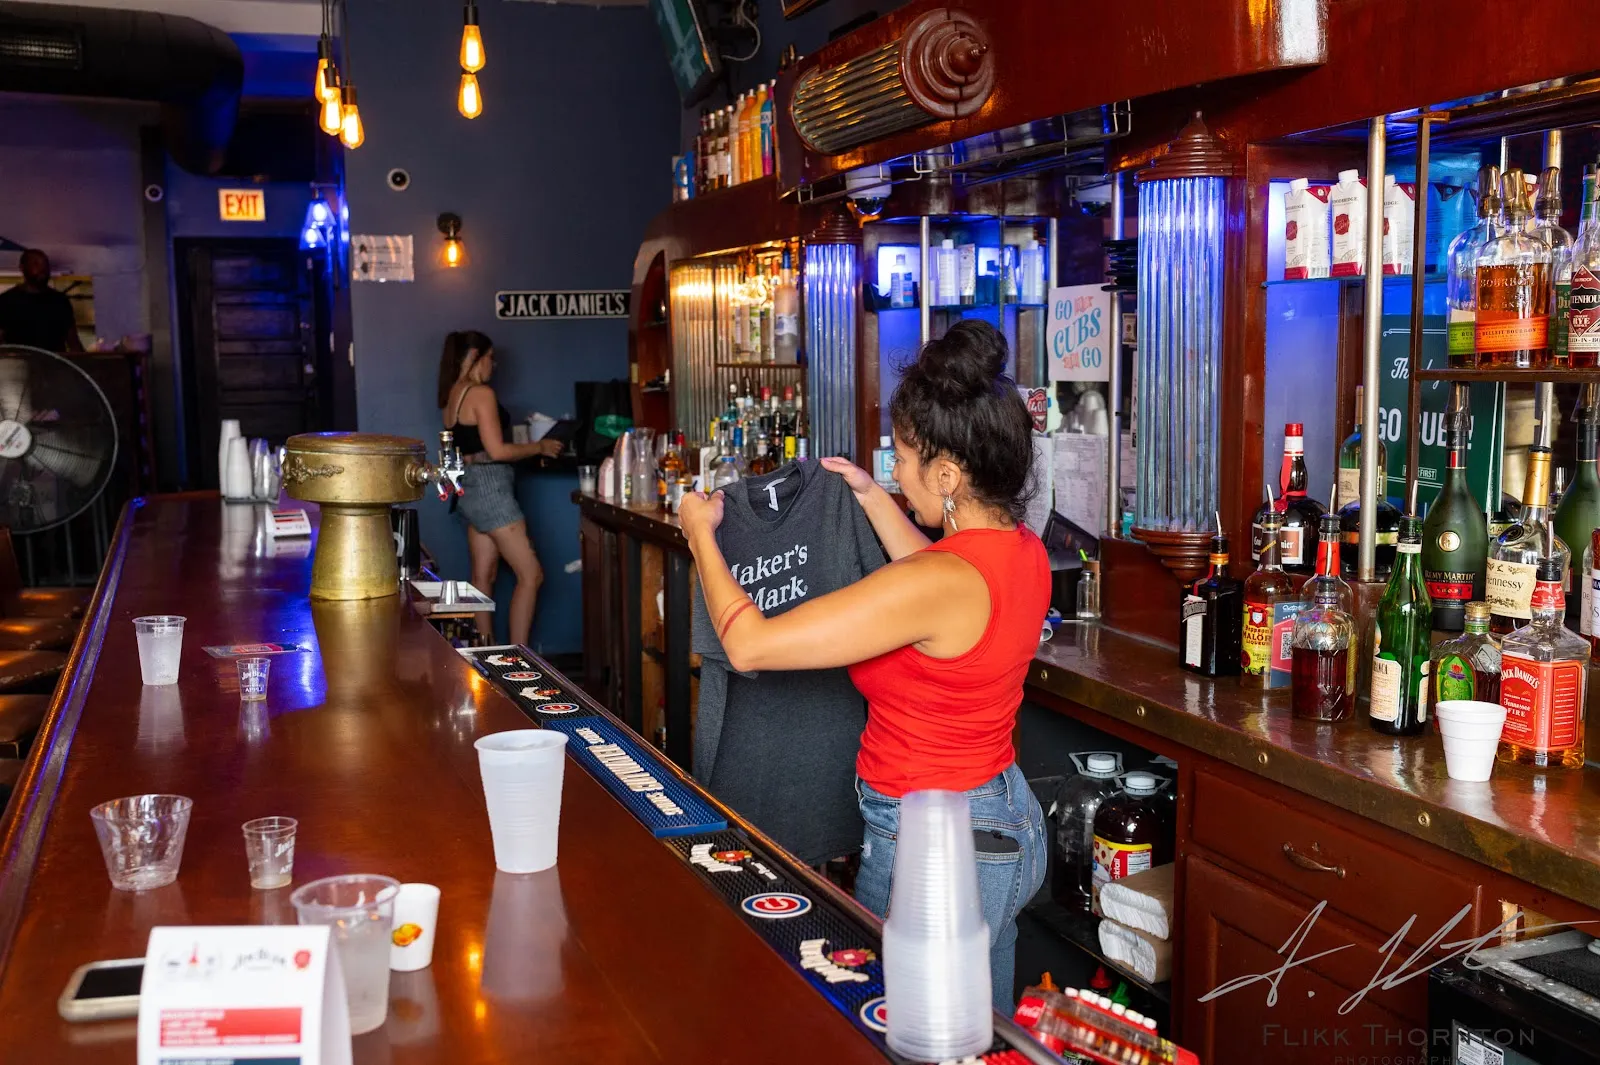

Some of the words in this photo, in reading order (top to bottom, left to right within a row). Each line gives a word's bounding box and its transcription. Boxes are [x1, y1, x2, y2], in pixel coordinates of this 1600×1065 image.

[225, 194, 259, 216] EXIT
[504, 294, 551, 317] JACK
[555, 293, 626, 316] DANIEL'S
[1054, 299, 1073, 321] GO
[1053, 306, 1102, 359] CUBS
[1081, 346, 1102, 369] GO
[1507, 708, 1526, 718] FIRE
[1113, 858, 1121, 880] cktail
